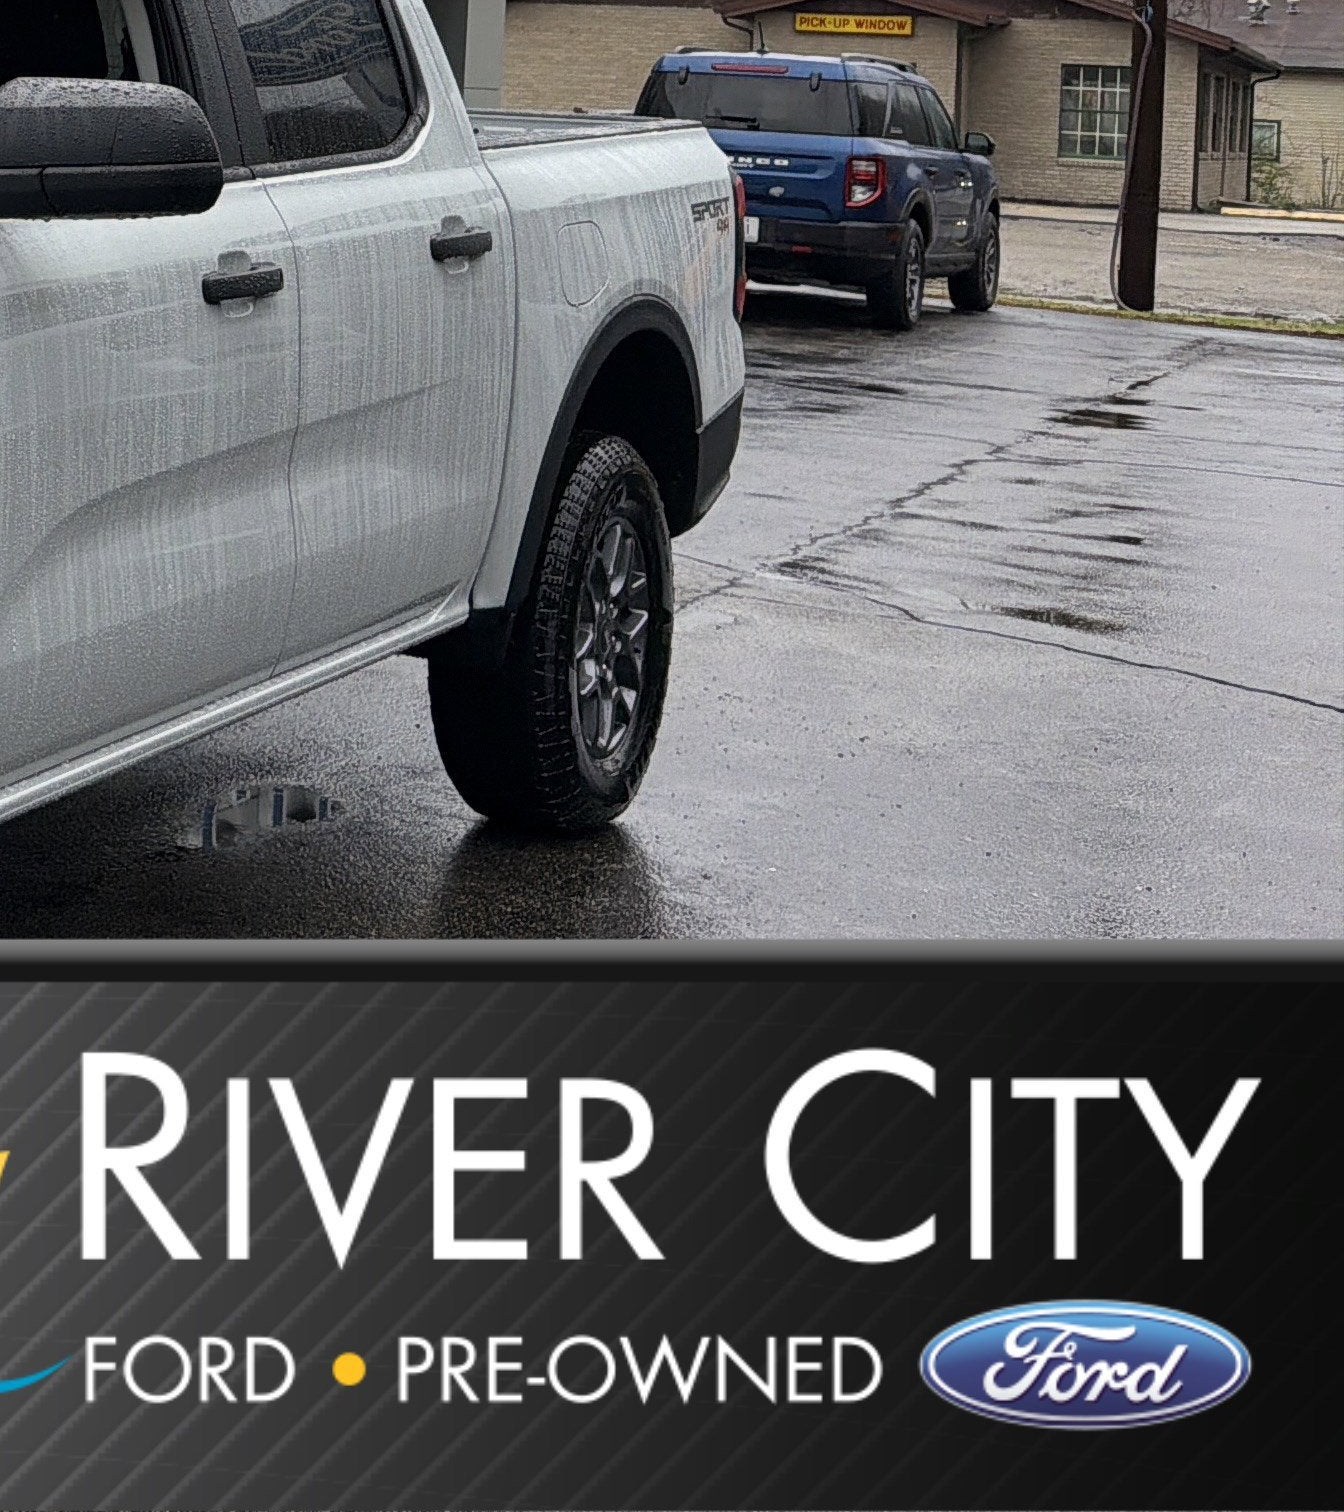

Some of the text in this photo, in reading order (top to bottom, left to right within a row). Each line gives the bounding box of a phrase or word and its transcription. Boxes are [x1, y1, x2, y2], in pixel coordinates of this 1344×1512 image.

[798, 15, 909, 31] PICK-UP WINDOW
[691, 197, 730, 223] SPORT
